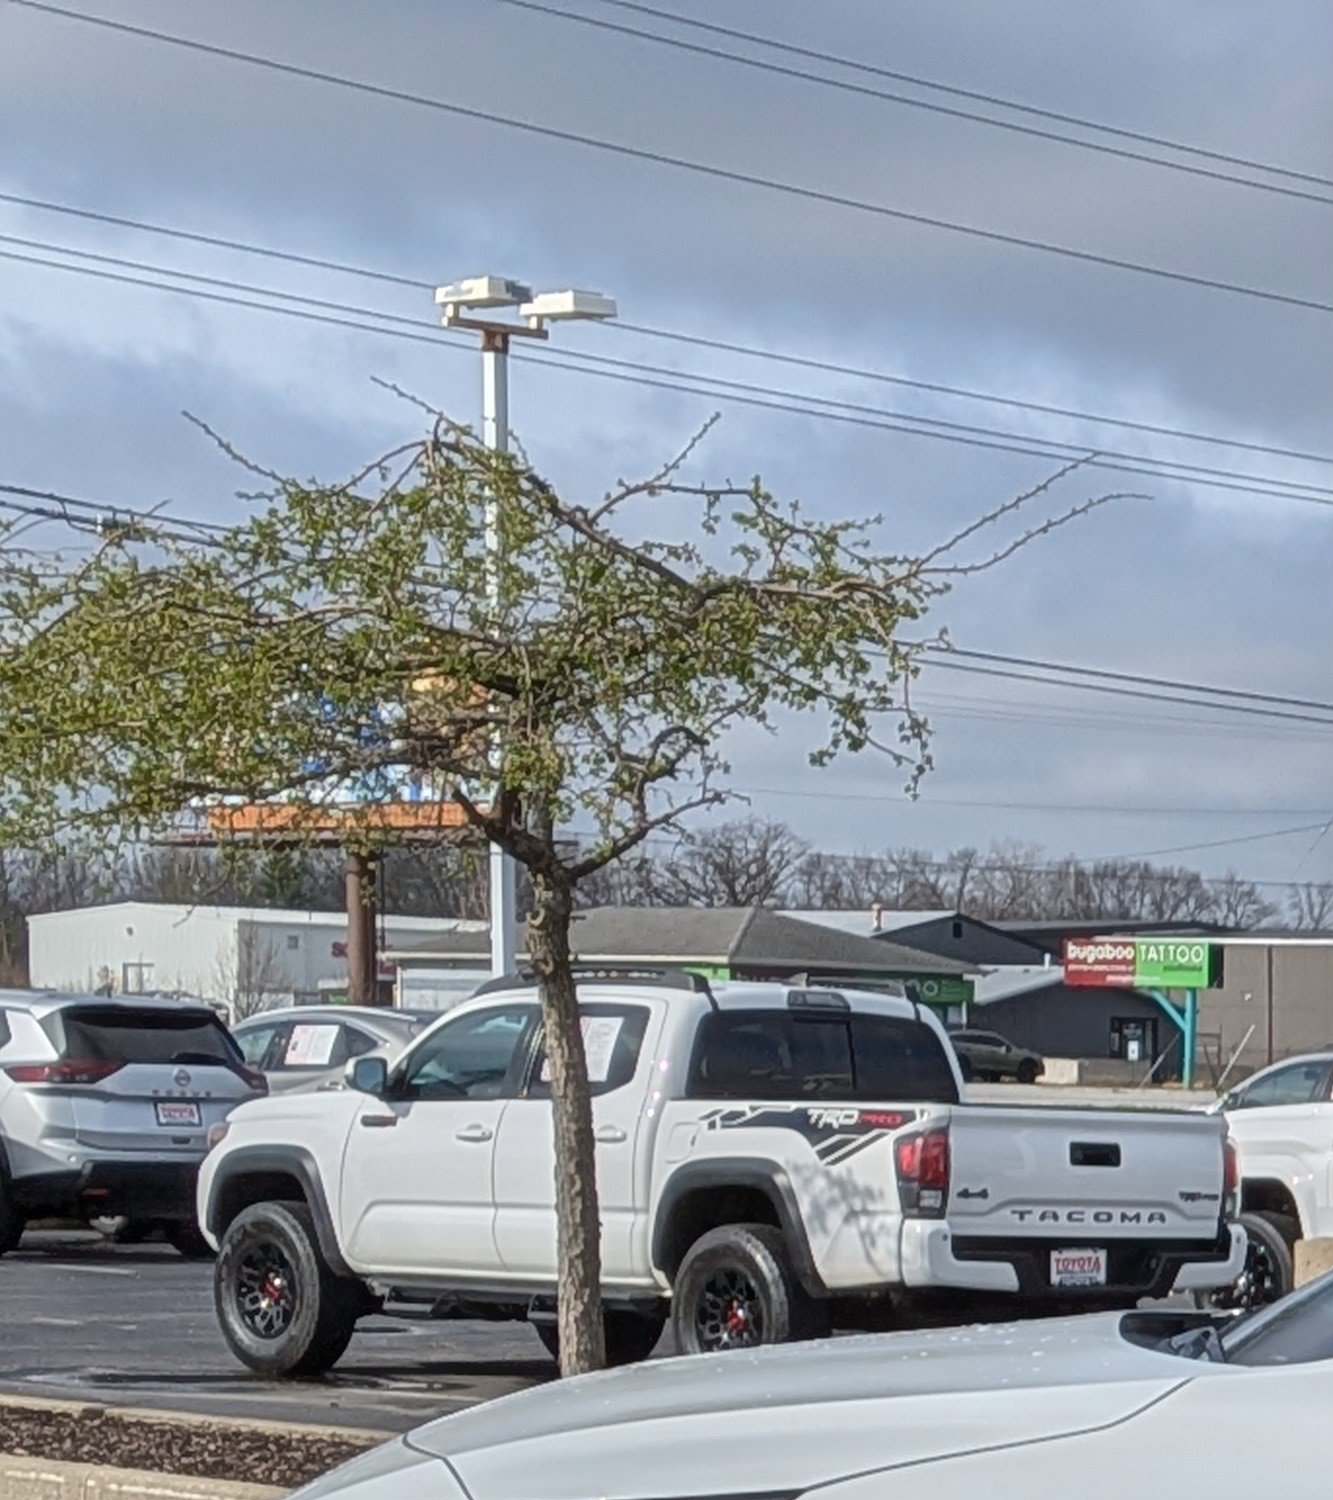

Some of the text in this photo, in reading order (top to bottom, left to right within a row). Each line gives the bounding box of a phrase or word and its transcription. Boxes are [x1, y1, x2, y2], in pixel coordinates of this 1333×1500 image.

[1066, 941, 1204, 963] bugaboo TATTOO
[1011, 1209, 1167, 1223] TACOMA
[1054, 1256, 1102, 1271] TOYOTA
